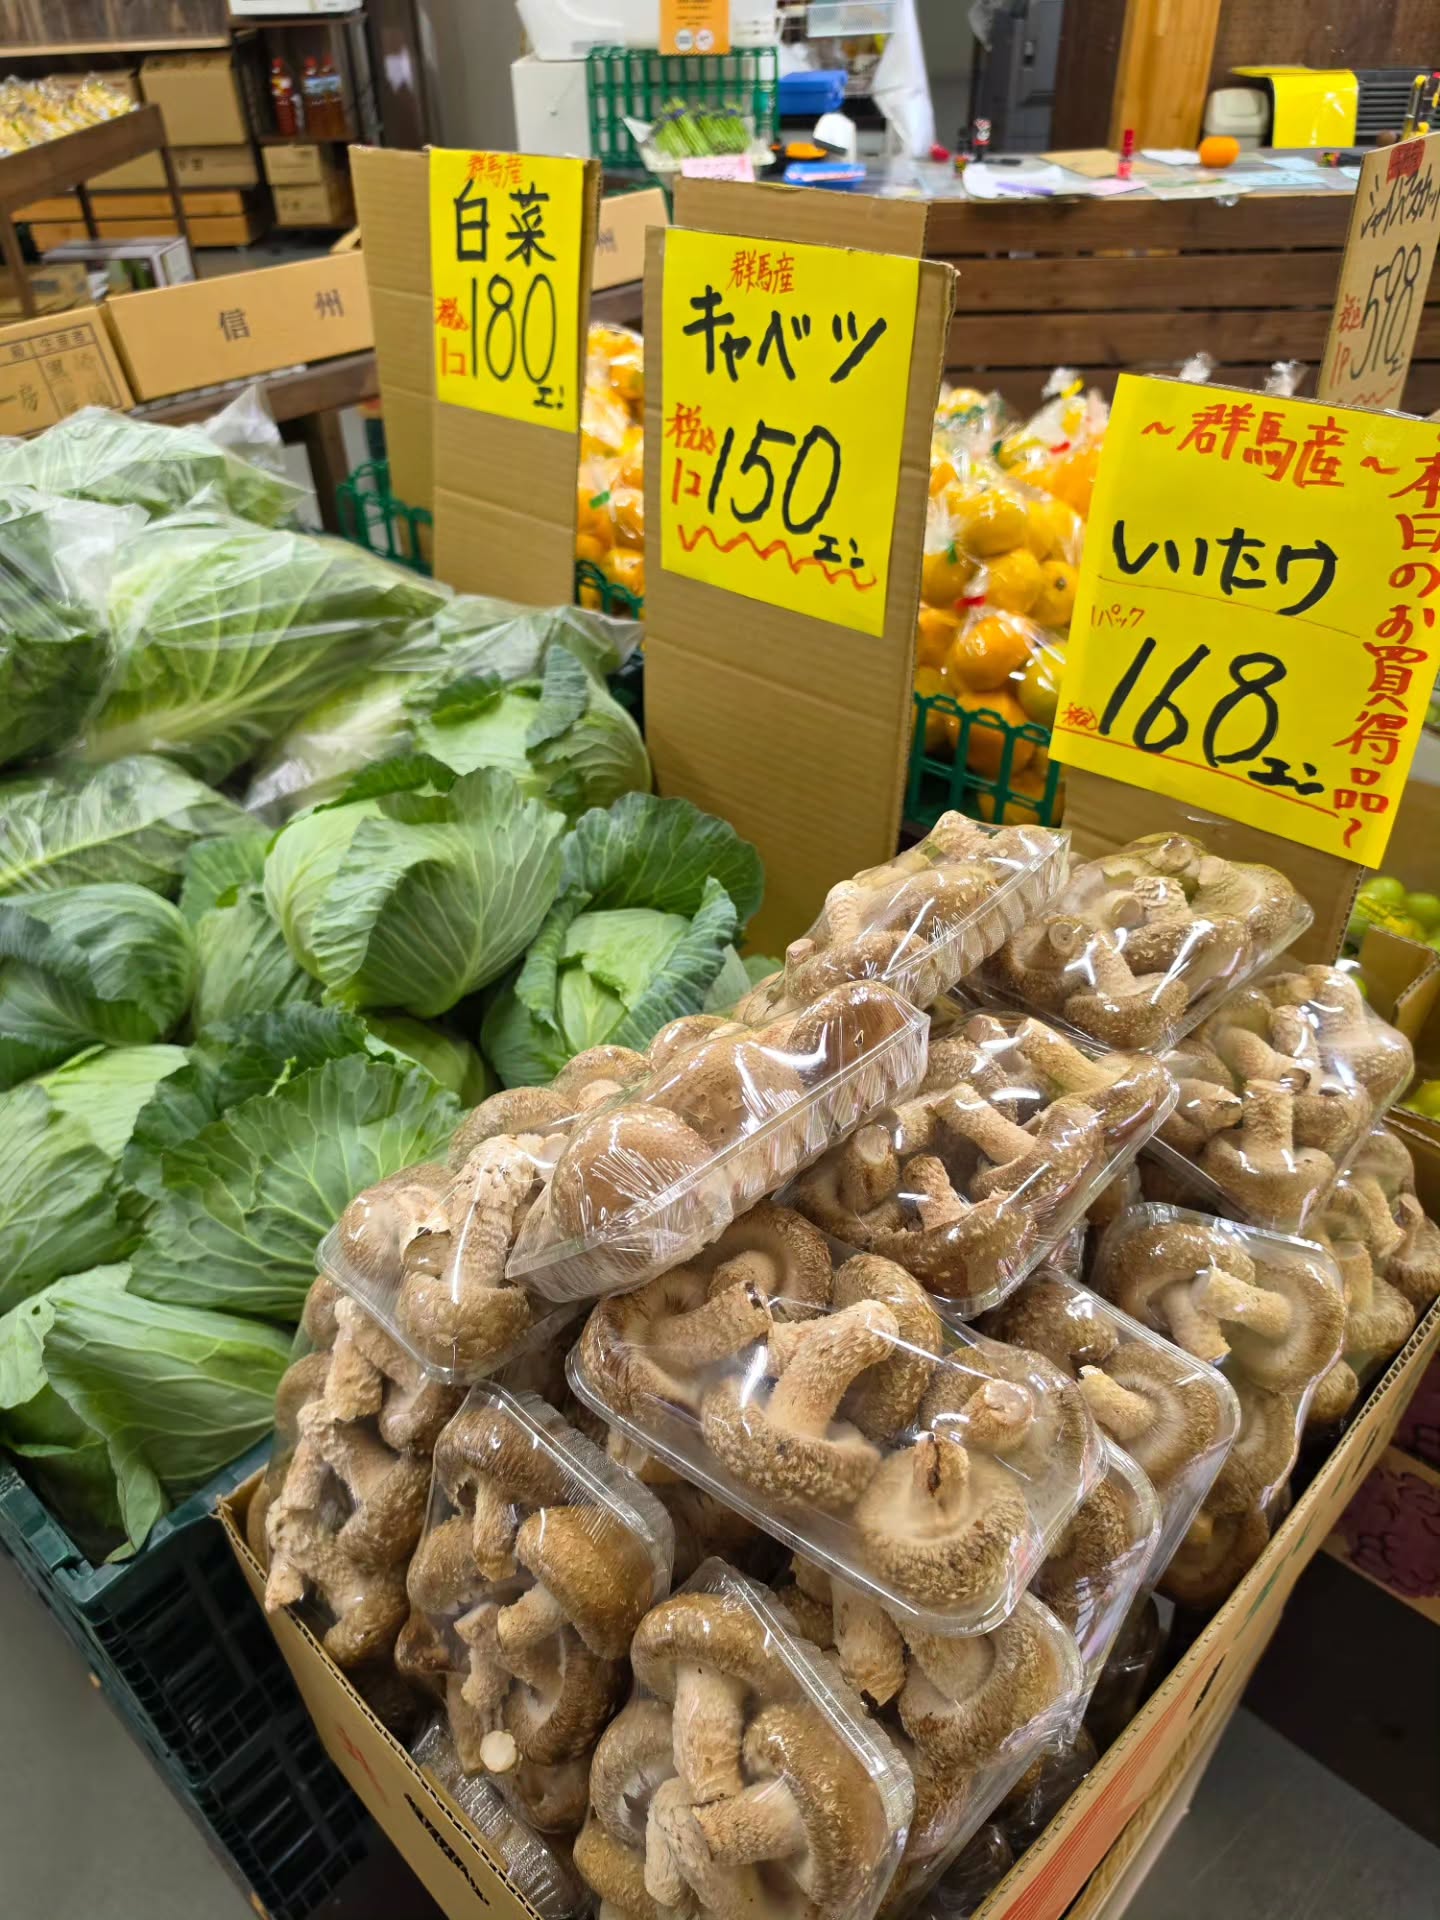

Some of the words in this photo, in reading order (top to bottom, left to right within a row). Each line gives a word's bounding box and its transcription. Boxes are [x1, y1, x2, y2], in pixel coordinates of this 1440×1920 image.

[454, 179, 556, 267] 白菜
[727, 250, 795, 293] 群馬産
[683, 285, 887, 383] キャベツ
[1091, 604, 1145, 629] 1パック
